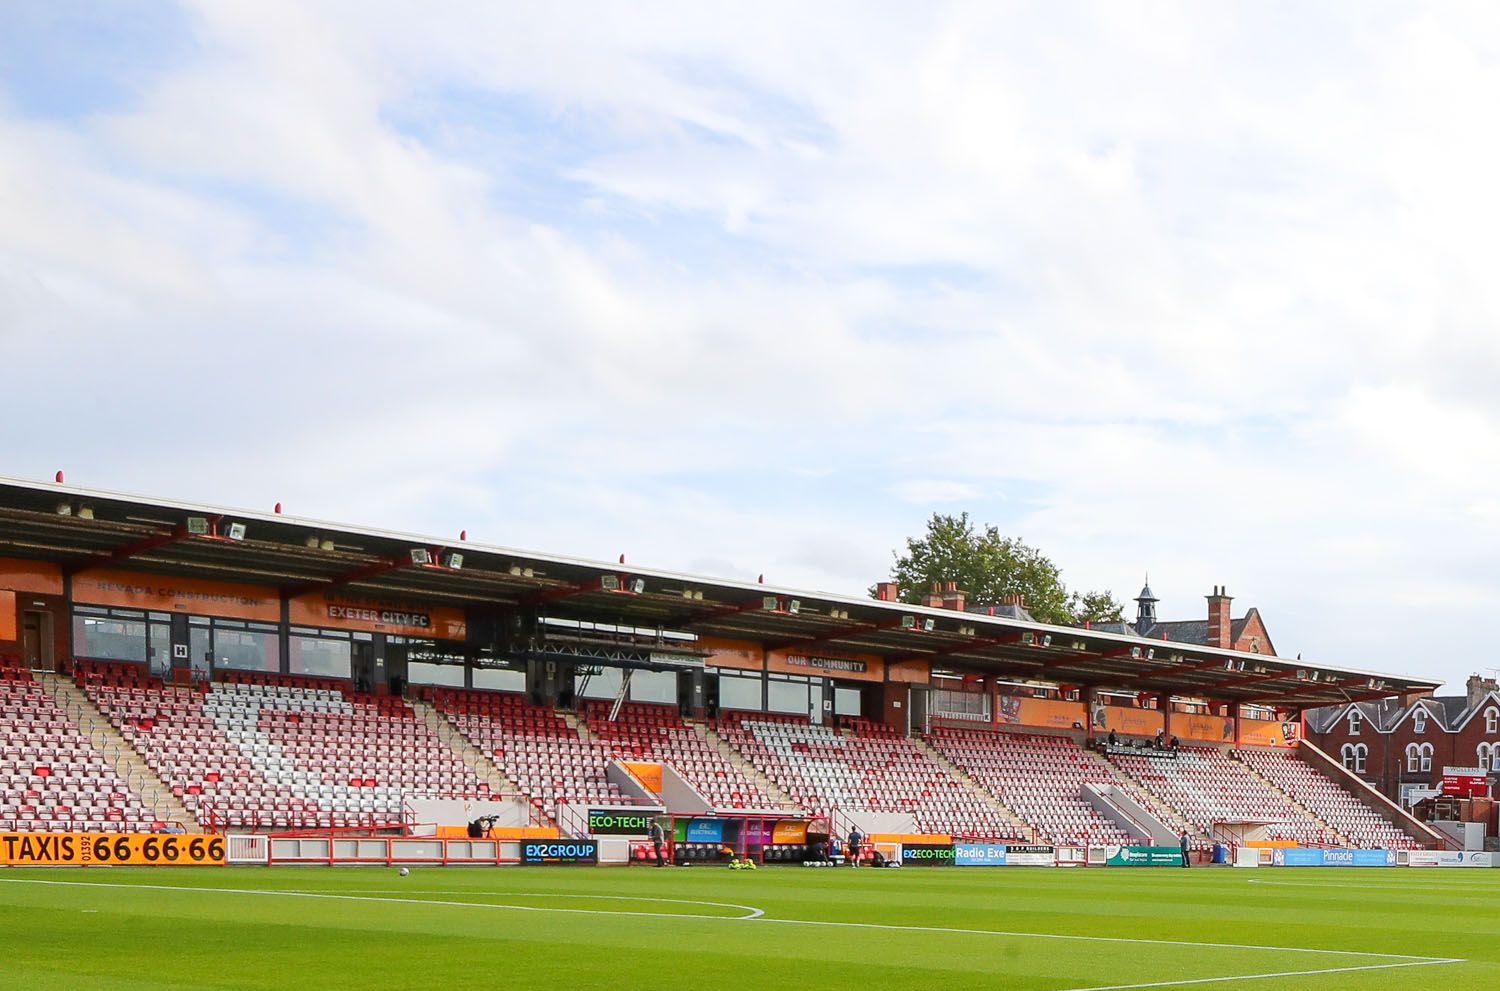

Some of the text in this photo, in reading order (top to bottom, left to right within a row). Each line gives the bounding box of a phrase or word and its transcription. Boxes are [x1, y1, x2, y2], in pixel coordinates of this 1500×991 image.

[97, 582, 258, 606] NEVADA CONSTRUCTION
[329, 606, 429, 627] EXETER CITY FC
[175, 646, 185, 656] H
[787, 655, 864, 672] OUR COMMUNITY
[589, 816, 646, 829] ECO-TECH
[3, 836, 75, 861] TAXIS
[81, 836, 91, 861] 01392
[526, 844, 594, 857] EX2GROUP
[956, 848, 1005, 859] Radio Exe
[1323, 849, 1353, 862] Pinnacle
